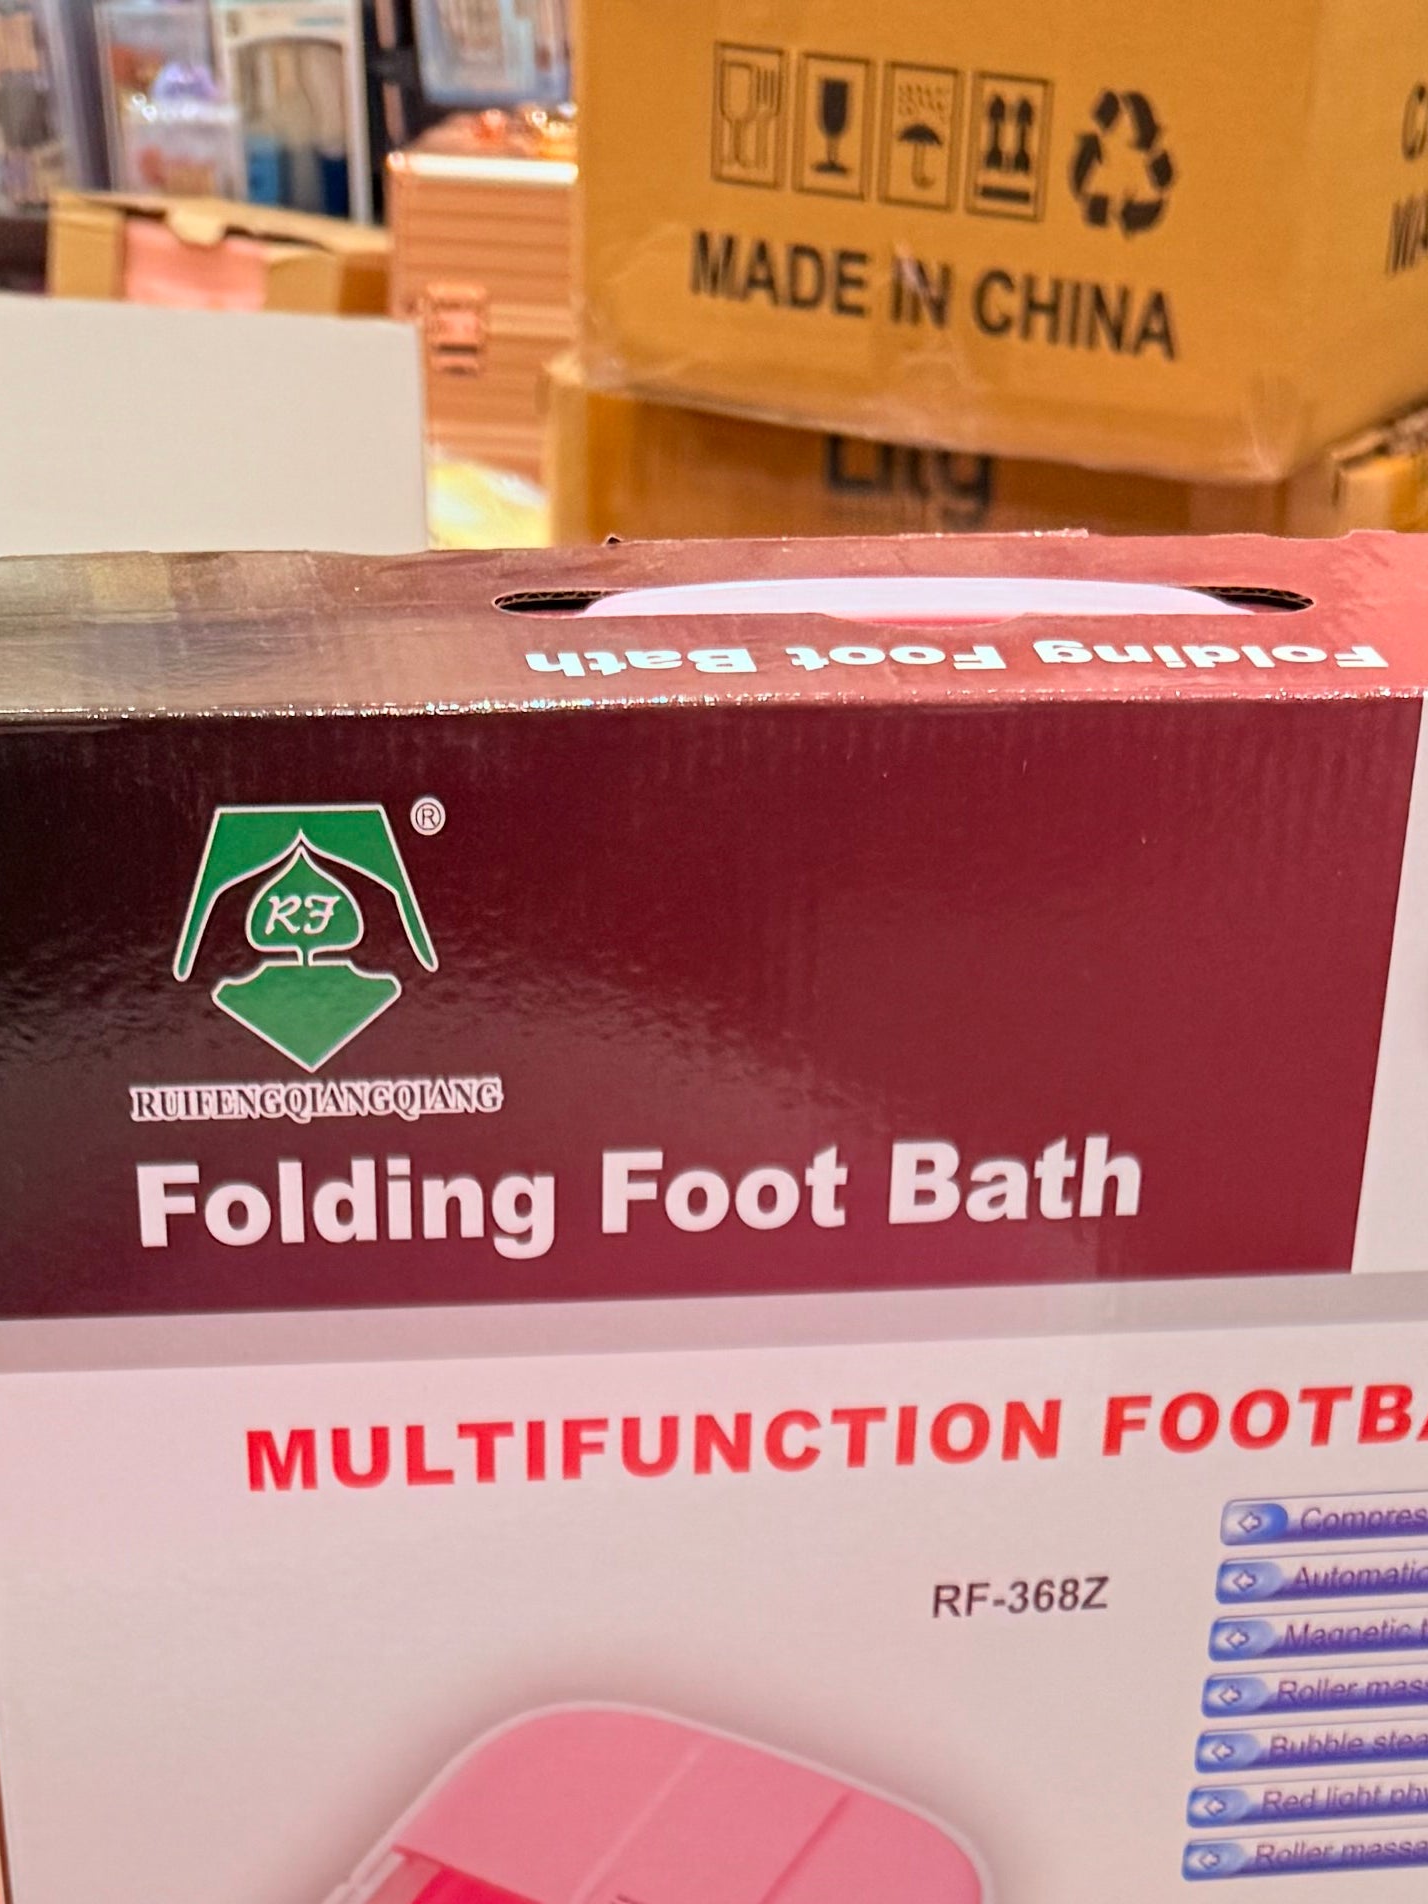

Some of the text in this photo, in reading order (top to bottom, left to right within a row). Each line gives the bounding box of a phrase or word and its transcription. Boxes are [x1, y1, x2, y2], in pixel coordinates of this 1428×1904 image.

[691, 228, 1179, 361] MADE IN CHINA
[525, 638, 1389, 677] Folding Foot Bath
[129, 1076, 504, 1123] RUIFENGQIANGQIANG
[135, 1134, 1142, 1260] Folding Foot Bath
[245, 1398, 1063, 1493] MULTIFUNCTION
[931, 1574, 1110, 1619] RF-368Z
[1283, 1615, 1412, 1650] Magnetic
[1277, 1677, 1358, 1703] Roller
[1270, 1732, 1364, 1757] Bubble
[1261, 1788, 1318, 1814] Red
[1325, 1784, 1383, 1810] light
[1256, 1843, 1334, 1867] Roller
